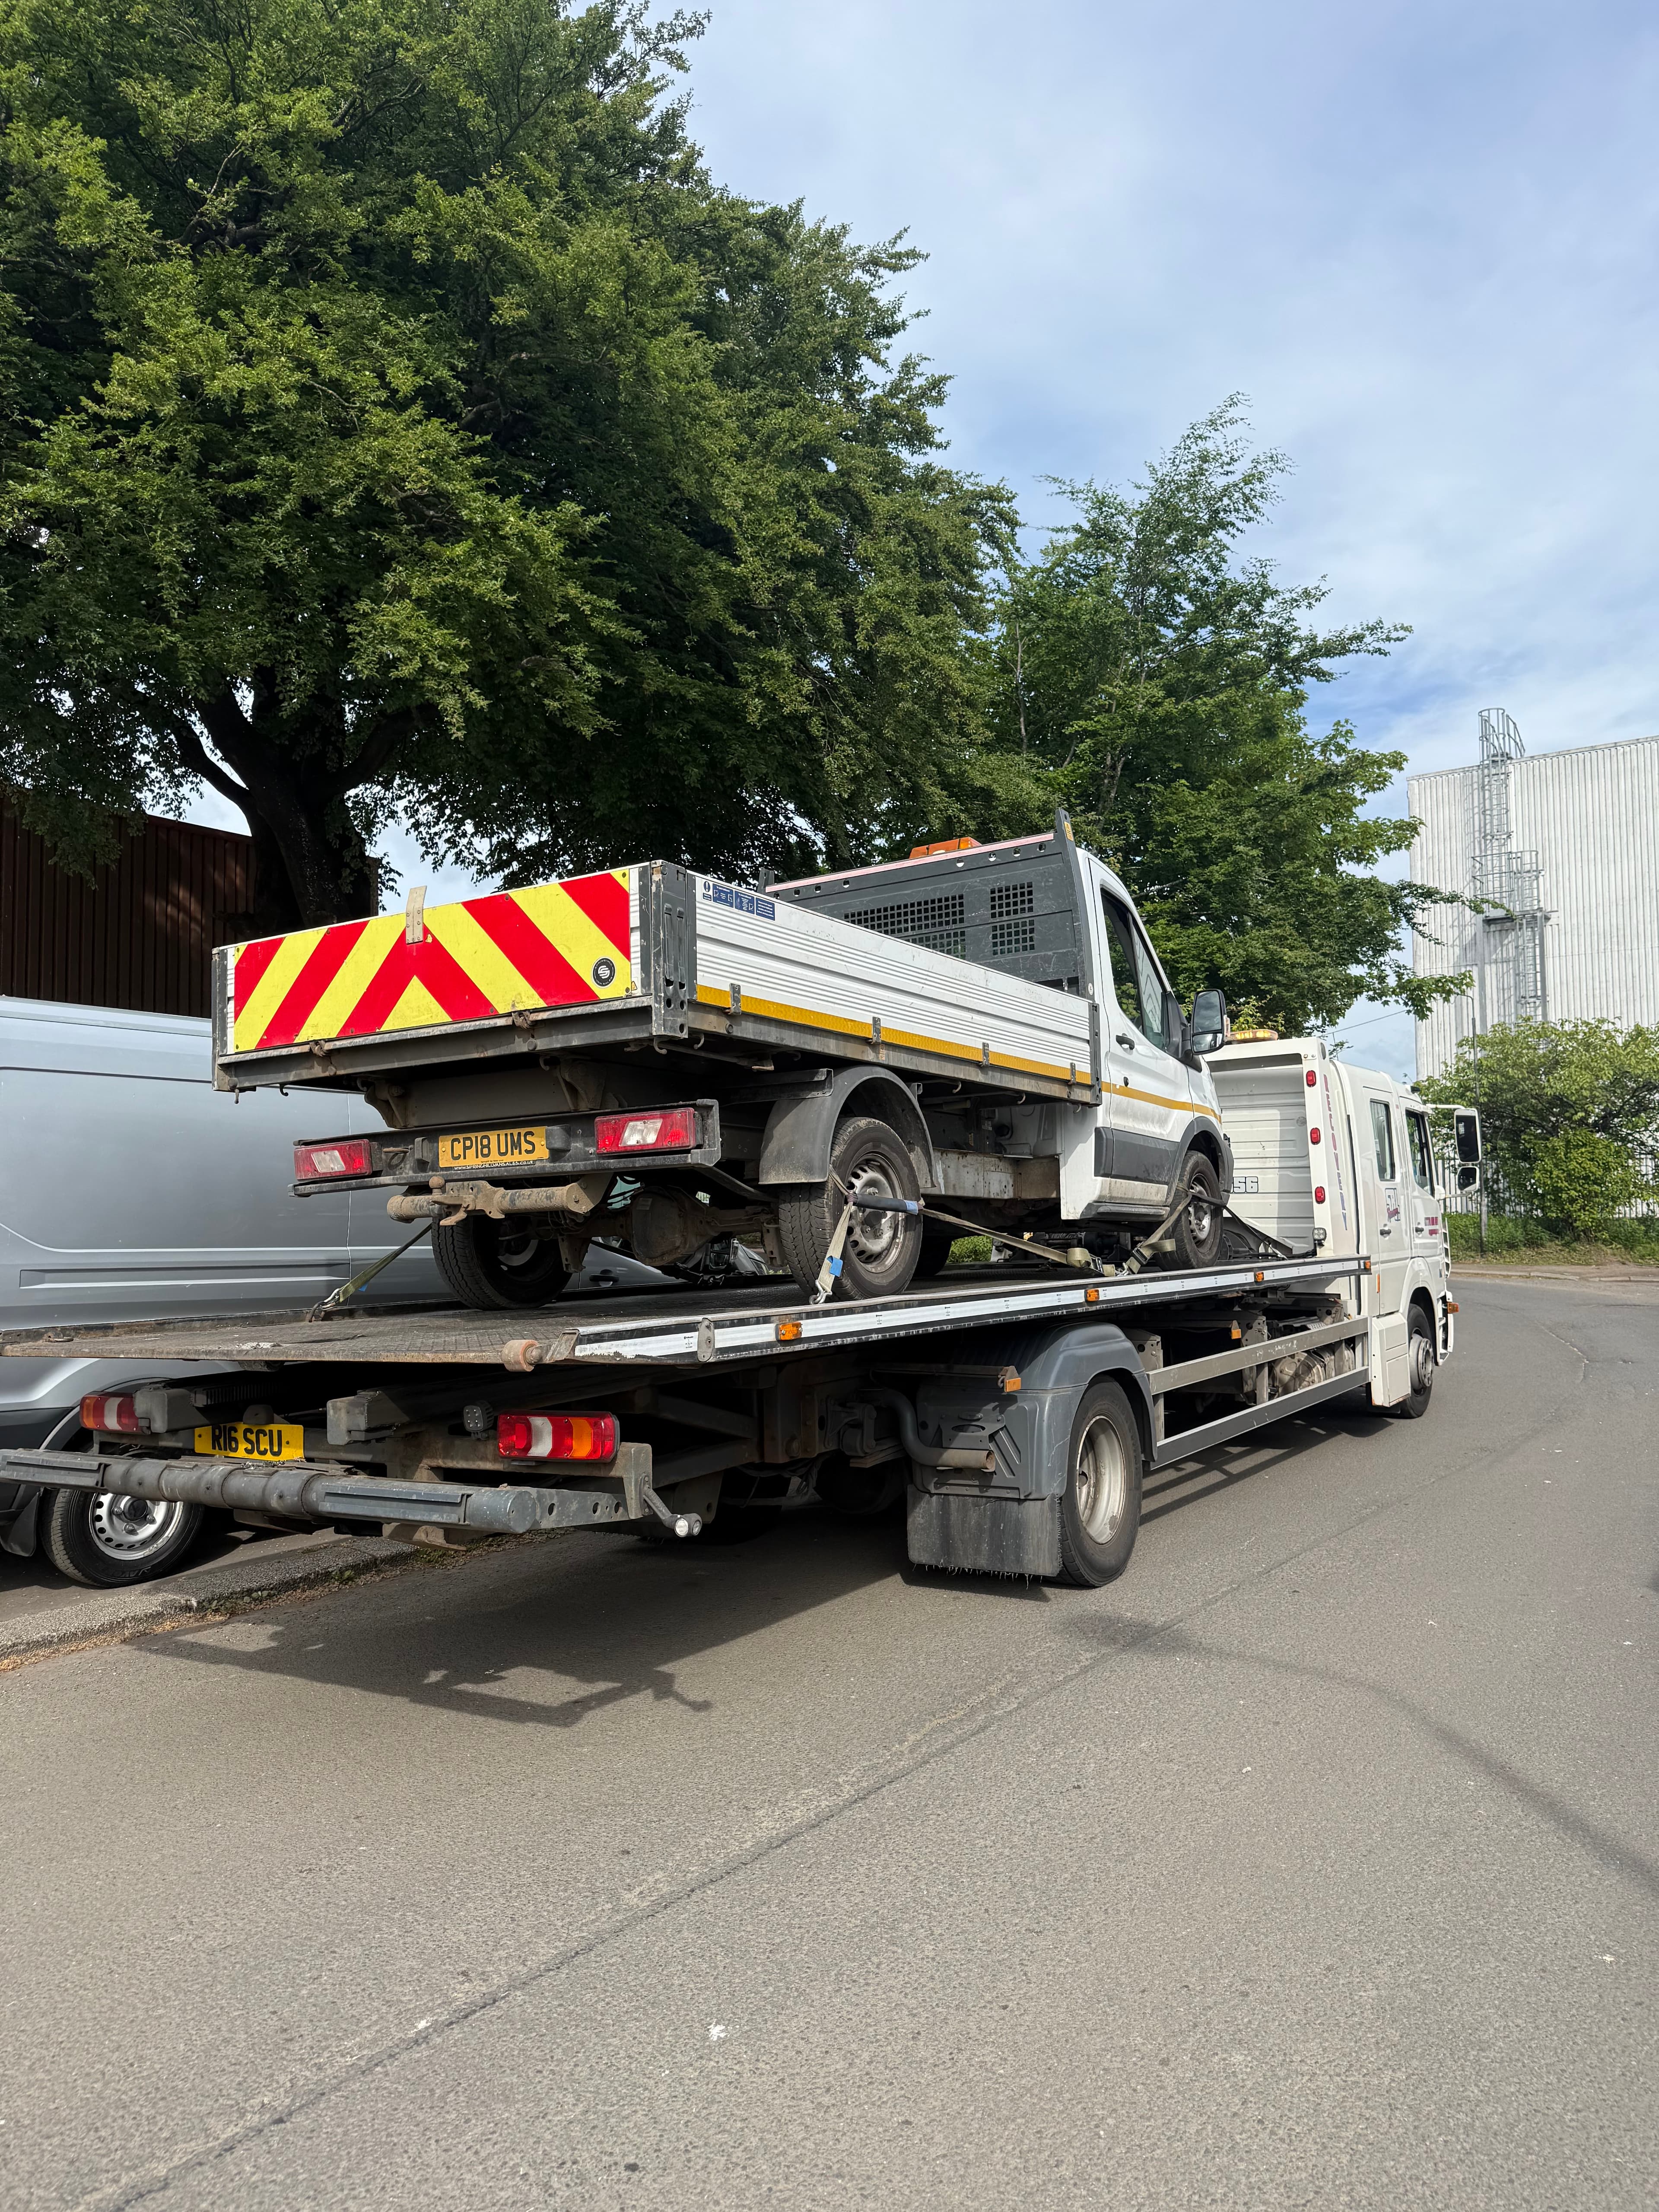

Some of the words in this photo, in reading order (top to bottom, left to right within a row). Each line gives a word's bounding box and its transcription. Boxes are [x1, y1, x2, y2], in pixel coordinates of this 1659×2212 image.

[451, 1135, 491, 1161] CP18
[497, 1131, 536, 1157] UMS
[1323, 1074, 1348, 1231] RECOVERY
[1230, 1176, 1259, 1194] 56
[211, 1425, 239, 1453] R16
[243, 1427, 283, 1457] SCU
